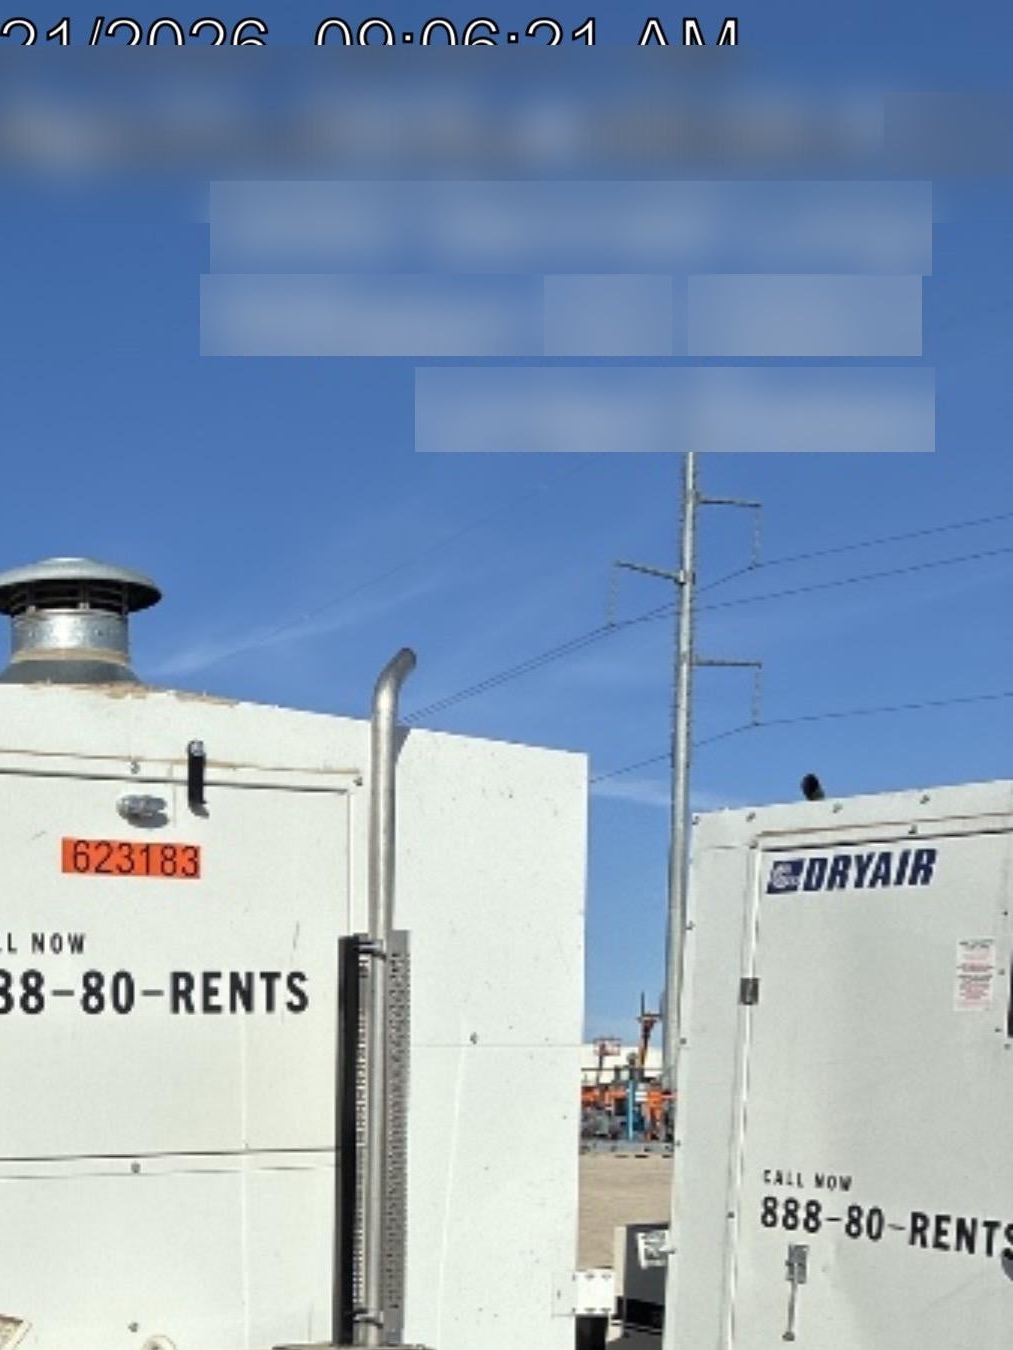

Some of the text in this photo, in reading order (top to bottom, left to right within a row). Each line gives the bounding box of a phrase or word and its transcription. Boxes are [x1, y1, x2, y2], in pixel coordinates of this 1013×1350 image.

[72, 839, 199, 877] 623183
[802, 848, 937, 892] DRYAIR
[31, 932, 86, 954] NOW
[763, 1169, 853, 1192] CALL NOW
